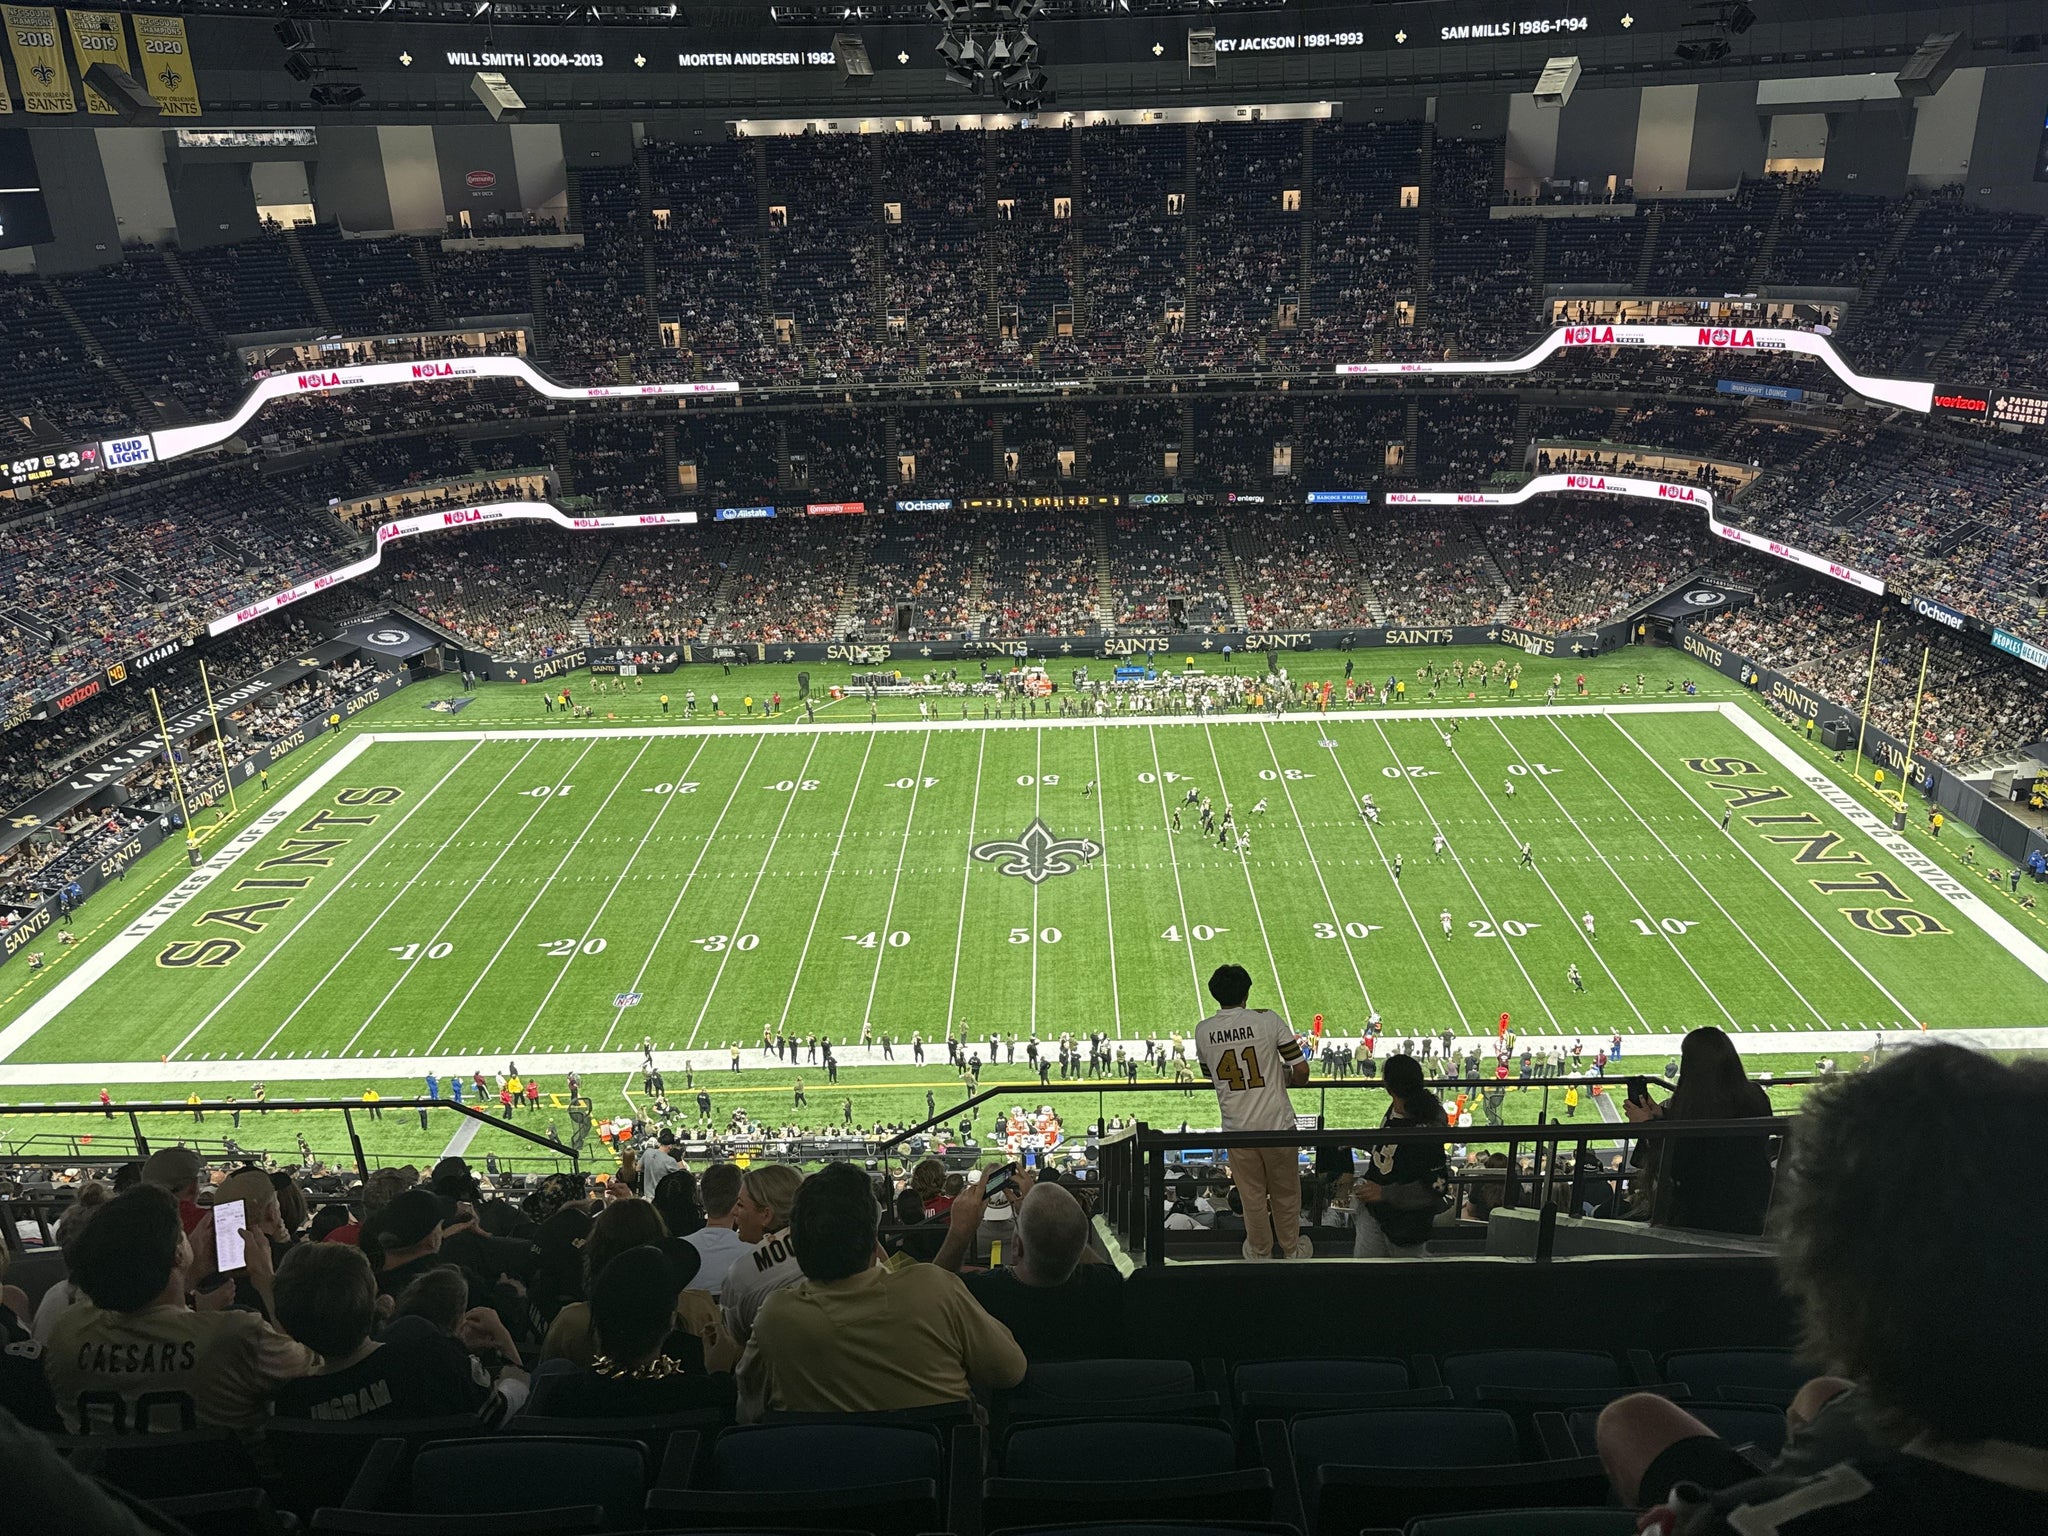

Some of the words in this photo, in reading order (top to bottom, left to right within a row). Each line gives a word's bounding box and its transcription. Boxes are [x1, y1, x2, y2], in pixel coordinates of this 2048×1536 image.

[8, 17, 53, 26] CHAMPIONS
[140, 26, 182, 35] CHAMPIONS
[1441, 26, 1470, 40] SAM
[1472, 23, 1510, 37] MILLS
[17, 31, 54, 46] 2018
[81, 36, 117, 51] 2019
[1239, 36, 1295, 51] JACKSON
[1304, 33, 1364, 47] 1981-1993
[145, 40, 182, 54] 2020
[447, 53, 480, 66] WILL
[484, 53, 525, 66] SMITH
[533, 54, 603, 67] 2004-2013
[678, 53, 731, 66] MORTEN
[734, 53, 799, 65] ANDERSEN
[28, 100, 73, 111] SAINTS
[162, 103, 198, 114] AINTS
[1565, 327, 1614, 344] NOLA
[1698, 329, 1755, 347] NOLA
[412, 363, 453, 378] NOLA
[1209, 366, 1237, 374] SAINTS
[1272, 365, 1300, 373] SAINTS
[1591, 372, 1620, 380] SAINTS
[298, 373, 341, 389] NOLA
[1655, 376, 1684, 384] SAINTS
[1732, 384, 1744, 392] BUD
[1745, 385, 1763, 393] LIGHT
[1765, 388, 1788, 398] LOUNGE
[466, 403, 494, 411] SAINTS
[1934, 395, 1986, 411] verizon
[2009, 397, 2048, 408] PATRON
[403, 410, 431, 420] SAINTS
[1993, 411, 2045, 424] PARTNERS
[2007, 405, 2047, 416] SAINTS
[344, 418, 371, 428] SAINTS
[287, 427, 312, 439] SAINTS
[112, 440, 142, 454] BUD
[58, 452, 80, 469] 23
[109, 449, 149, 465] LIGHT
[12, 458, 39, 474] 6:17
[1567, 476, 1605, 490] NOLA
[1145, 495, 1168, 503] COX
[1187, 494, 1214, 502] SAINTS
[1237, 495, 1264, 503] entergy
[1659, 485, 1694, 502] NOLA
[810, 505, 844, 513] Community
[905, 501, 950, 511] Ochsner
[444, 509, 482, 525] NOLA
[640, 515, 665, 524] NOLA
[737, 510, 767, 518] Allstate
[574, 519, 600, 527] NOLA
[1722, 527, 1741, 540] NOLA
[1769, 542, 1789, 557] NOLA
[1830, 564, 1850, 579] NOLA
[314, 575, 334, 589] NOLA
[277, 590, 297, 605] NOLA
[1888, 585, 1912, 600] SAINTS
[237, 607, 259, 622] NOLA
[1918, 601, 1963, 630] Ochsner
[181, 626, 205, 642] SAINTS
[1246, 633, 1312, 650] SAINTS
[1386, 629, 1454, 644] SAINTS
[1501, 629, 1555, 654] SAINTS
[1105, 638, 1170, 652] SAINTS
[1684, 636, 1723, 667] SAINTS
[1993, 633, 2021, 654] PEOPLES
[2023, 646, 2048, 667] HEALTH
[136, 642, 179, 669] CAESARS
[534, 651, 587, 680] SAINTS
[56, 681, 100, 711] verizon
[347, 688, 379, 715] SAINTS
[1773, 681, 1819, 718] SAINTS
[167, 679, 272, 734] SUPERDOME
[3, 711, 32, 731] SAINTS
[269, 731, 305, 760] SAINTS
[1382, 766, 1430, 779] 20
[1507, 763, 1553, 776] 10
[1884, 746, 1926, 784] AINTS
[897, 777, 939, 789] 40
[1016, 774, 1060, 787] 50
[1137, 771, 1184, 783] 40
[1259, 769, 1303, 782] 30
[531, 785, 574, 798] 10
[654, 782, 700, 794] 20
[776, 780, 820, 791] 30
[187, 779, 226, 815] SAINTS
[1804, 776, 1871, 820] SALUTE
[1862, 819, 1893, 838] TO
[1887, 843, 1972, 900] SERVICE
[1680, 757, 1953, 937] SAINTS
[125, 924, 154, 936] IT
[150, 875, 210, 918] TAKES
[208, 847, 245, 869] ALL
[237, 828, 266, 843] OF
[265, 811, 288, 826] US
[156, 786, 405, 968] SAINTS
[4, 908, 51, 955] SAINTS
[1161, 924, 1215, 942] 40
[1314, 921, 1370, 940] 30
[1468, 919, 1528, 938] 20
[1630, 917, 1688, 936] 10
[703, 934, 760, 952] 30
[856, 931, 911, 949] 40
[1008, 926, 1063, 945] 50
[396, 941, 453, 960] 10
[546, 938, 607, 956] 20
[619, 999, 638, 1007] NFL
[1209, 1026, 1254, 1045] KAMARA
[1217, 1046, 1265, 1091] 41
[78, 1341, 195, 1374] CAESARS
[310, 1380, 392, 1421] INGRAM
